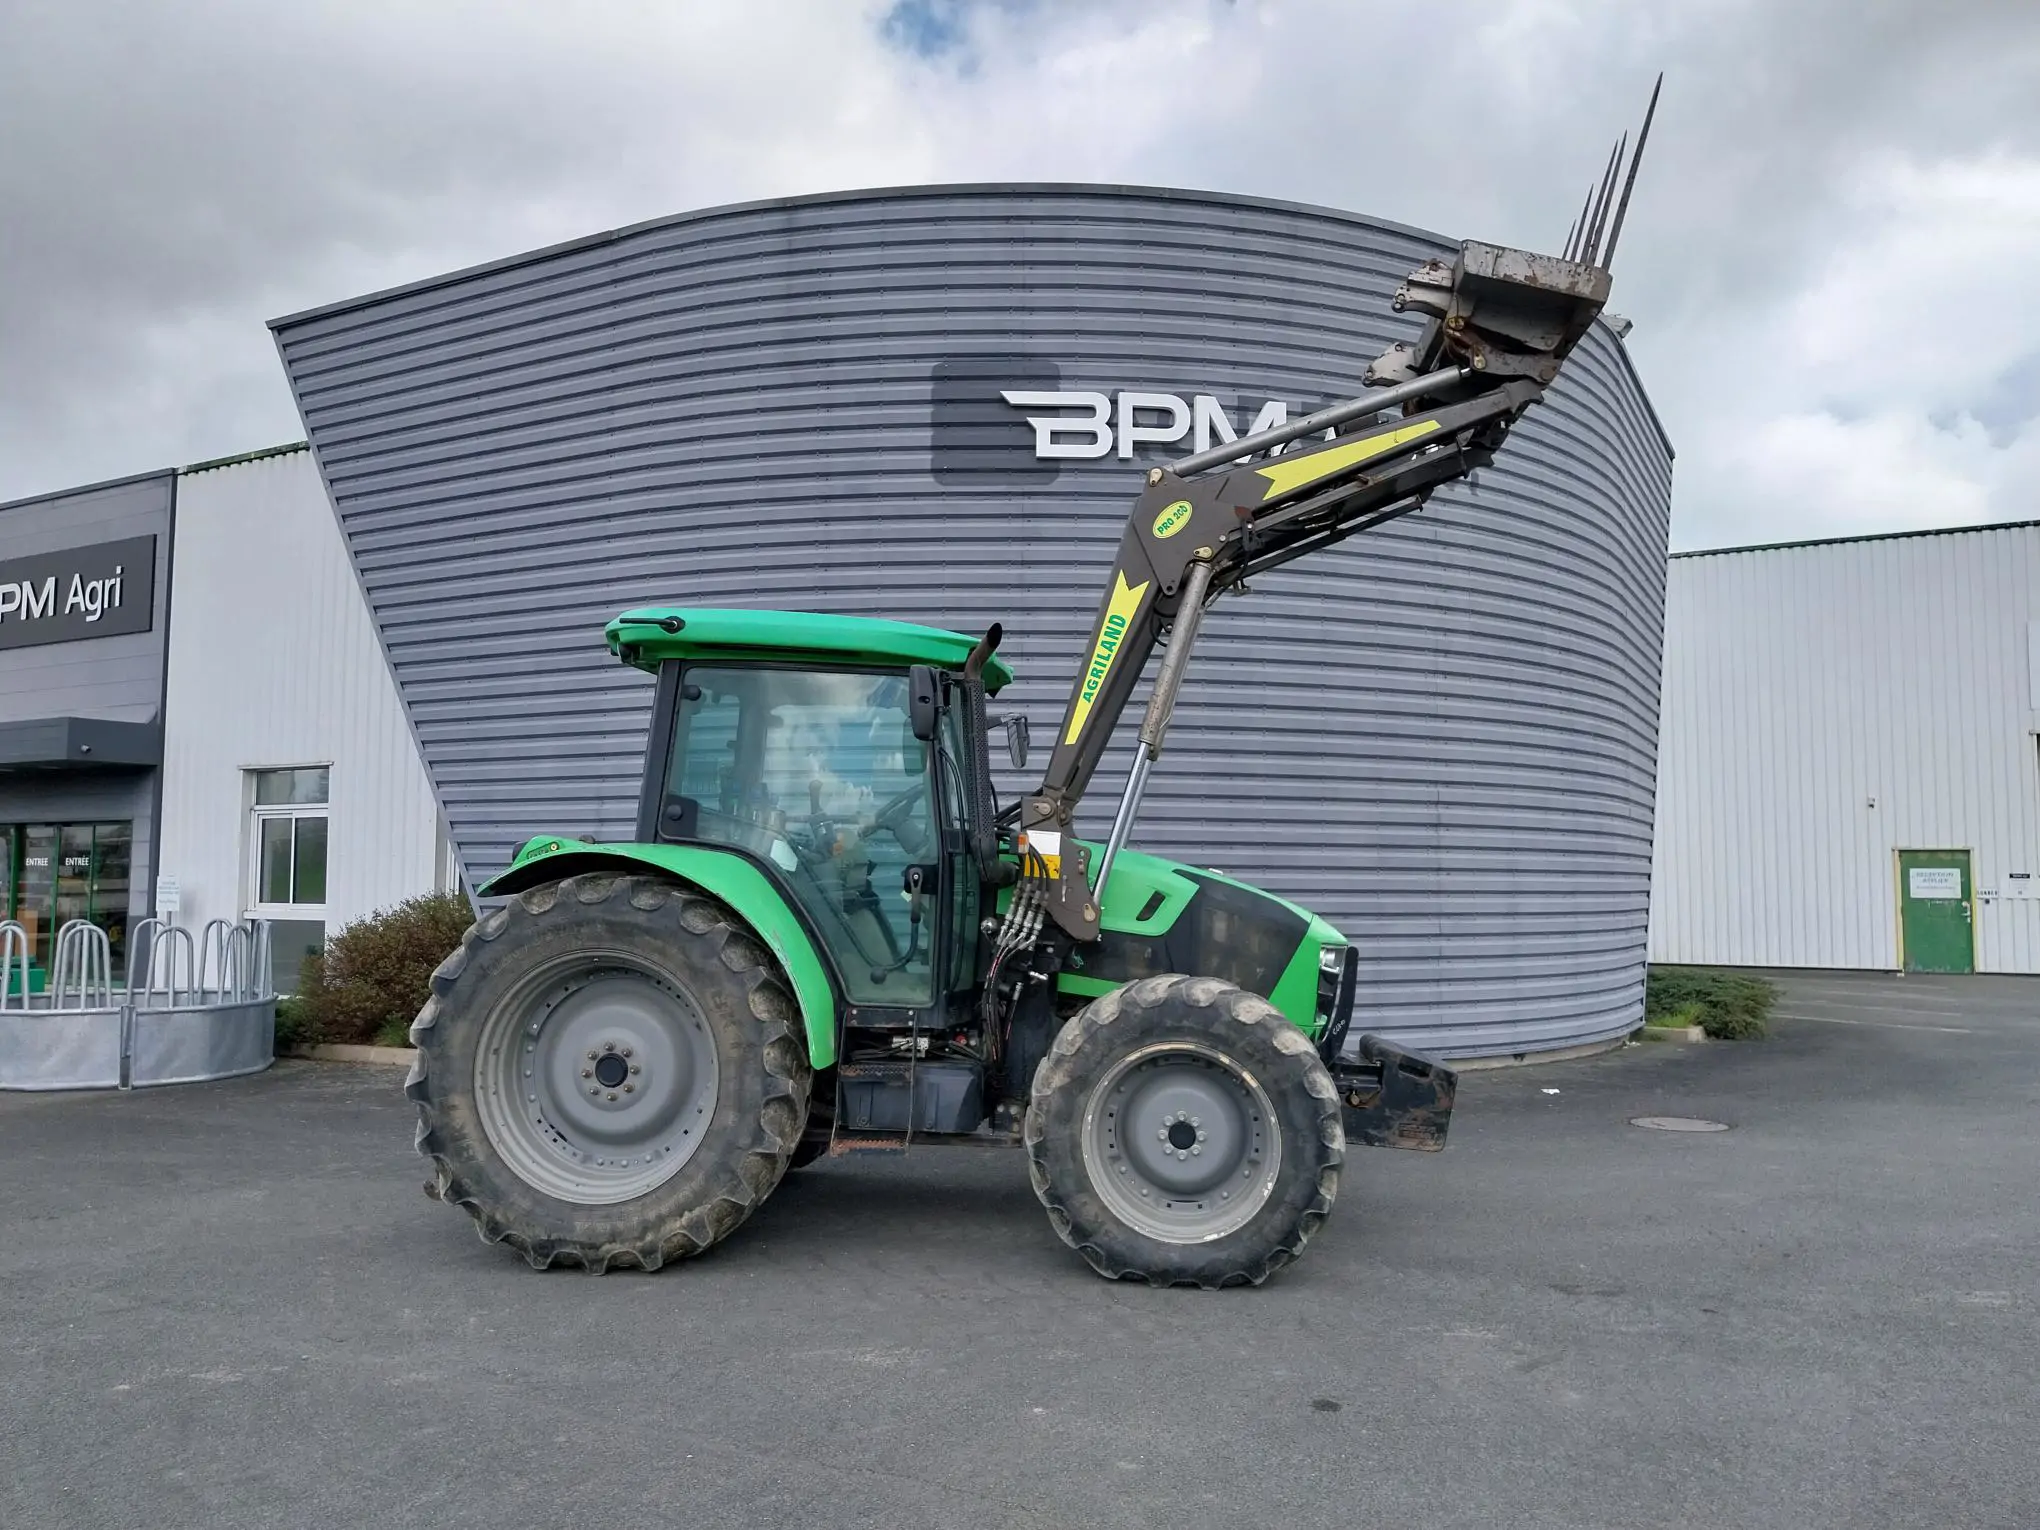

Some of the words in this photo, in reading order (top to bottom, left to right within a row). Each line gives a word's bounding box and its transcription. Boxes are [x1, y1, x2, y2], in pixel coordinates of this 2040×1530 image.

[1000, 391, 1287, 464] BPM
[1157, 518, 1174, 534] PRO
[1173, 505, 1188, 520] 200
[65, 566, 122, 622] Agri
[1083, 614, 1126, 703] AGRILAND
